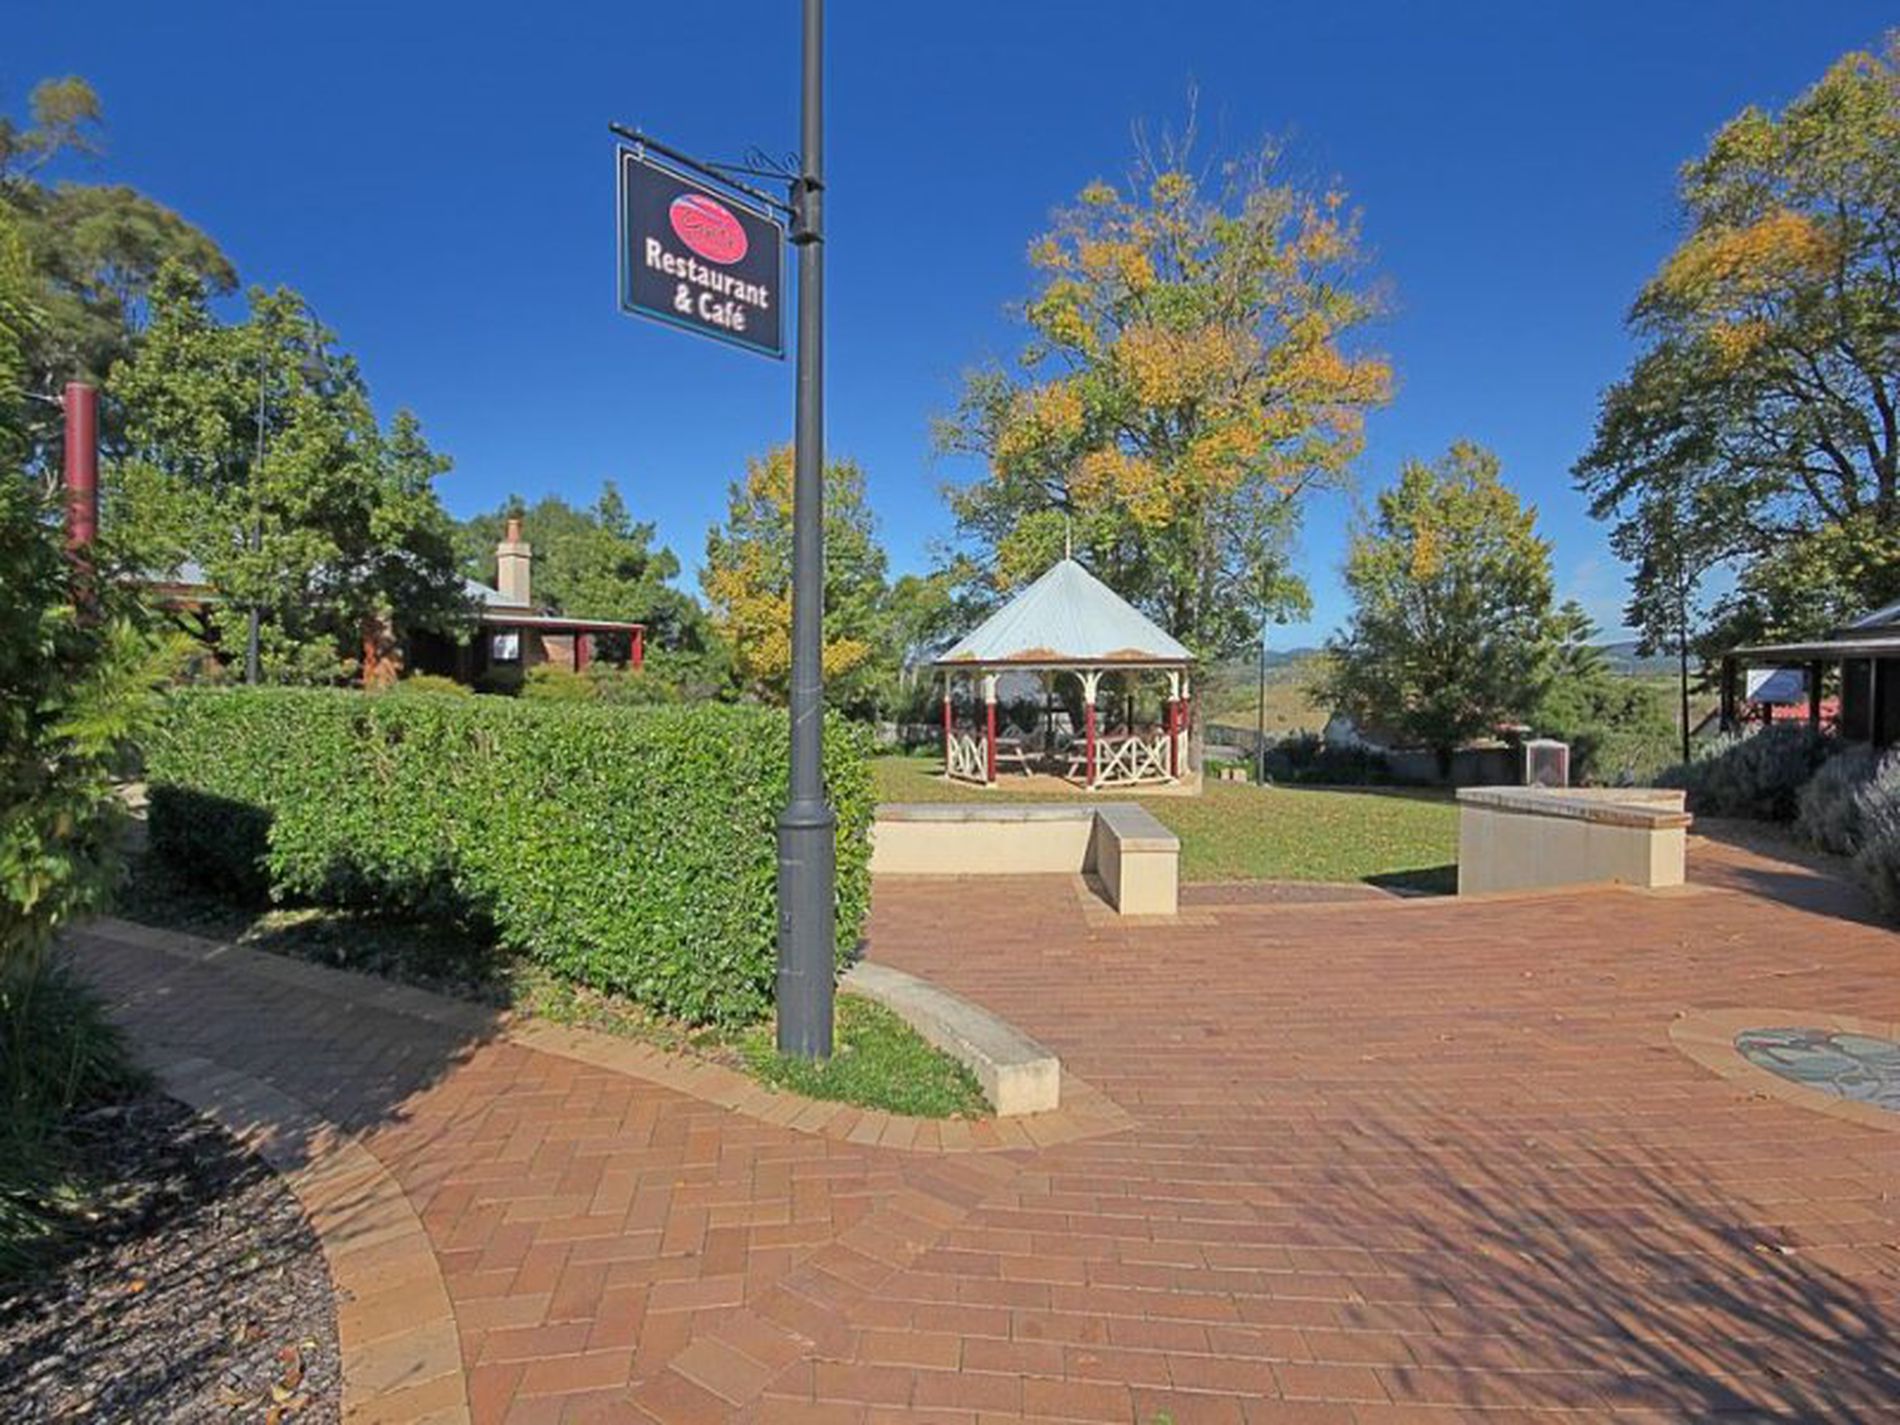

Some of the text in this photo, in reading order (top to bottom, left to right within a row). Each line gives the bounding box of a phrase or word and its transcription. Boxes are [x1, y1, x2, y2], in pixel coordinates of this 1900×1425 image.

[645, 238, 769, 308] Restaurant
[674, 284, 746, 331] & Café
